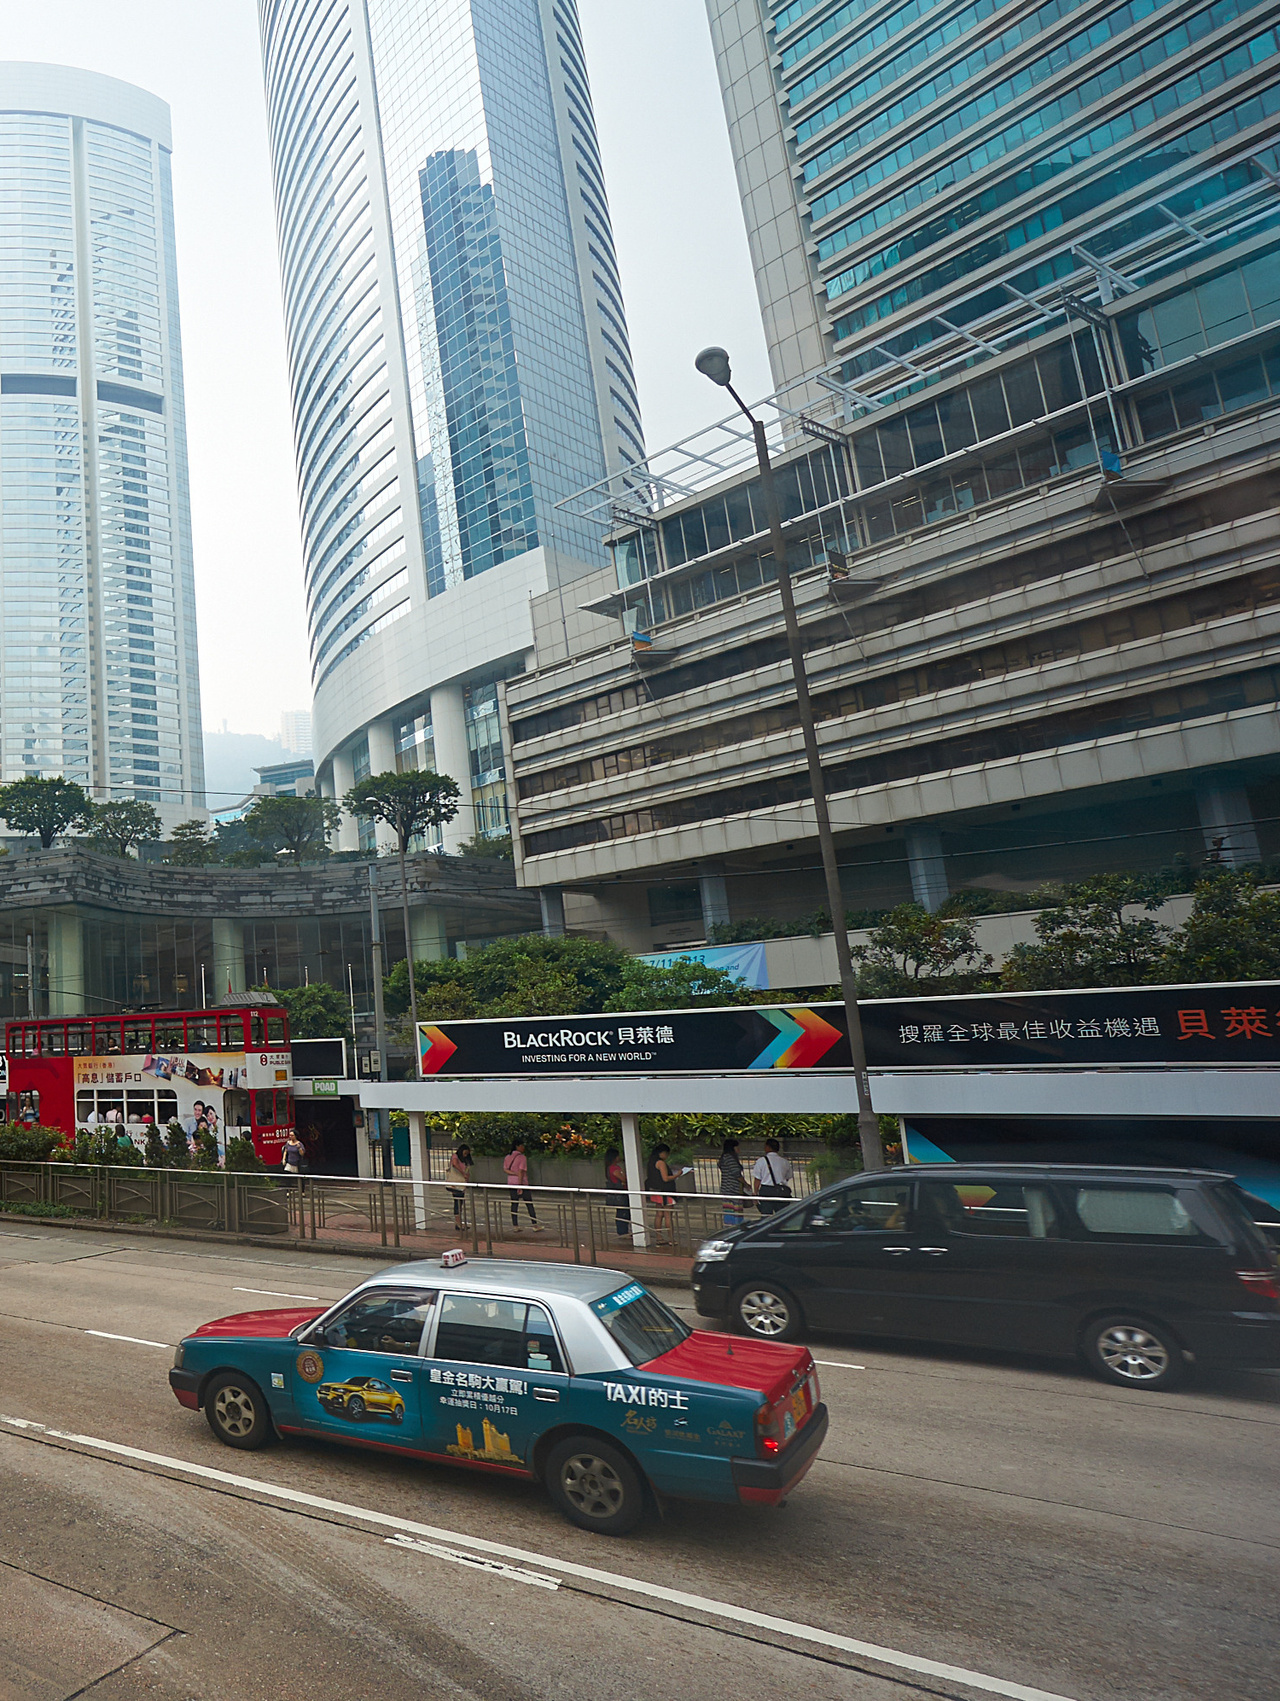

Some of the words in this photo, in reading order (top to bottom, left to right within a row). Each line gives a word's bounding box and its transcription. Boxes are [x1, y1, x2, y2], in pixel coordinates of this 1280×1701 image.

[1176, 1006, 1280, 1041] 貝萊
[618, 1025, 675, 1046] 貝萊德
[898, 1015, 1162, 1045] 搜羅全球最佳收益機遇
[521, 1053, 567, 1063] INVESTING
[568, 1053, 586, 1062] FOR
[587, 1053, 595, 1062] A
[596, 1052, 617, 1062] NEW
[314, 1083, 336, 1092] POAD
[275, 1128, 288, 1138] 8107
[451, 1252, 465, 1263] TAXI
